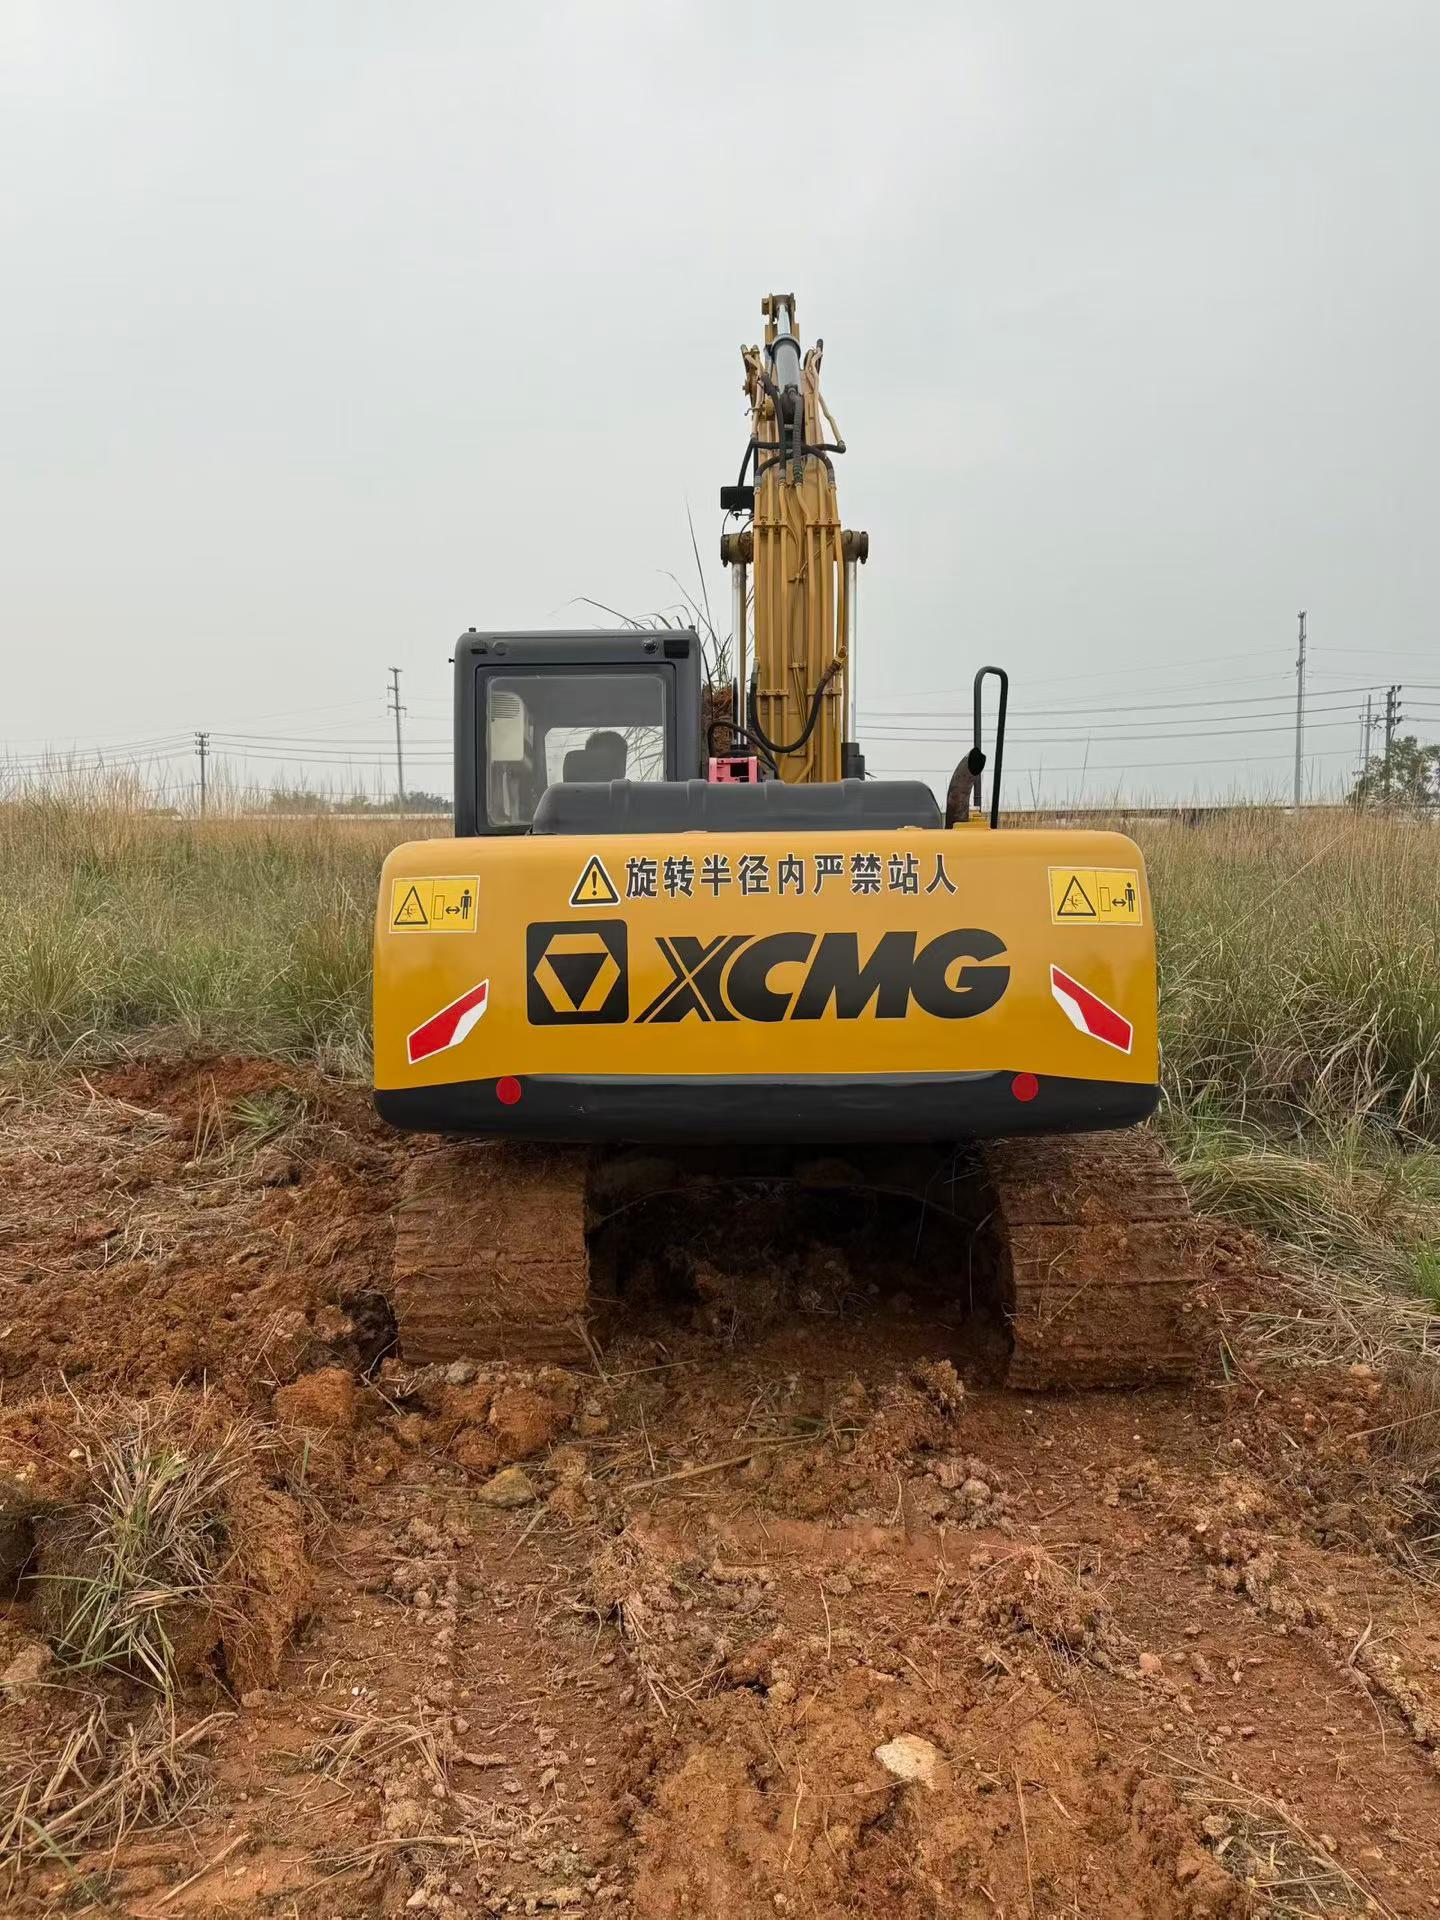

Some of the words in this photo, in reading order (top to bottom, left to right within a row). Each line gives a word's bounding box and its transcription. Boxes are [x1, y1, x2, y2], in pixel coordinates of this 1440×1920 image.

[626, 853, 957, 898] 旋转半径内严禁站人
[633, 928, 1010, 1023] XCMG
